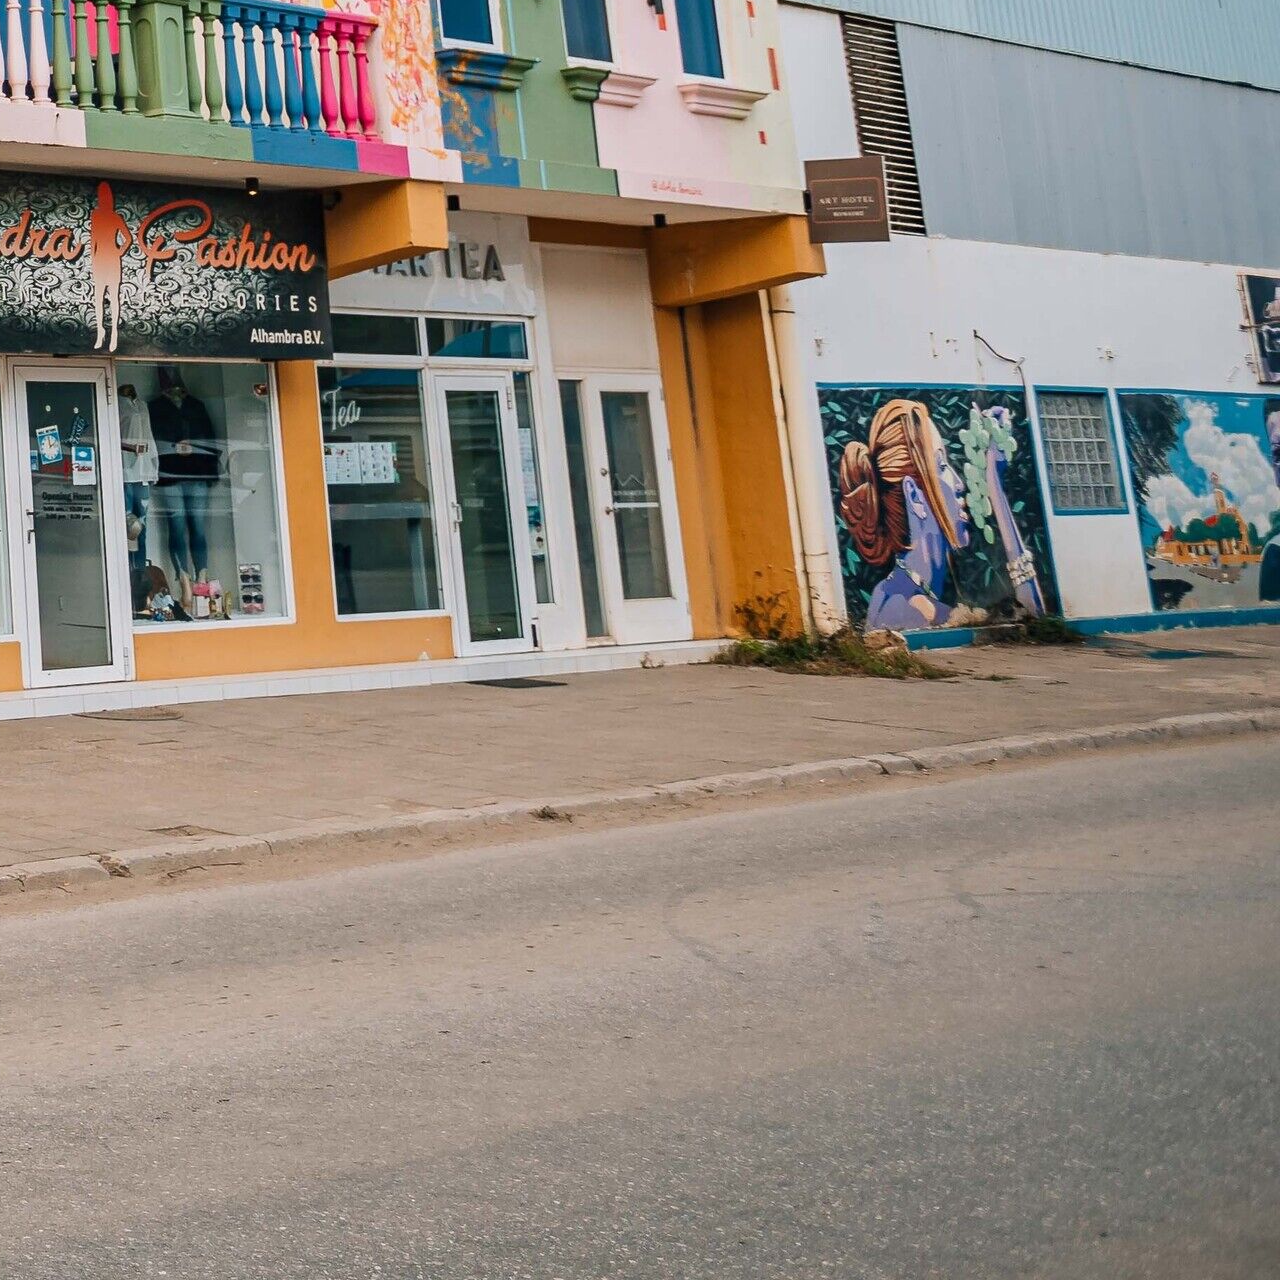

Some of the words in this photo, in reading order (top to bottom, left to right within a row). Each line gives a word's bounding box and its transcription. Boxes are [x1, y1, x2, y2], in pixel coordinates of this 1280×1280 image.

[138, 198, 318, 282] Fashion
[121, 288, 318, 313] ACCESSORIES
[250, 327, 303, 345] Alhambra
[304, 329, 324, 346] B.V.
[322, 385, 361, 432] Tea
